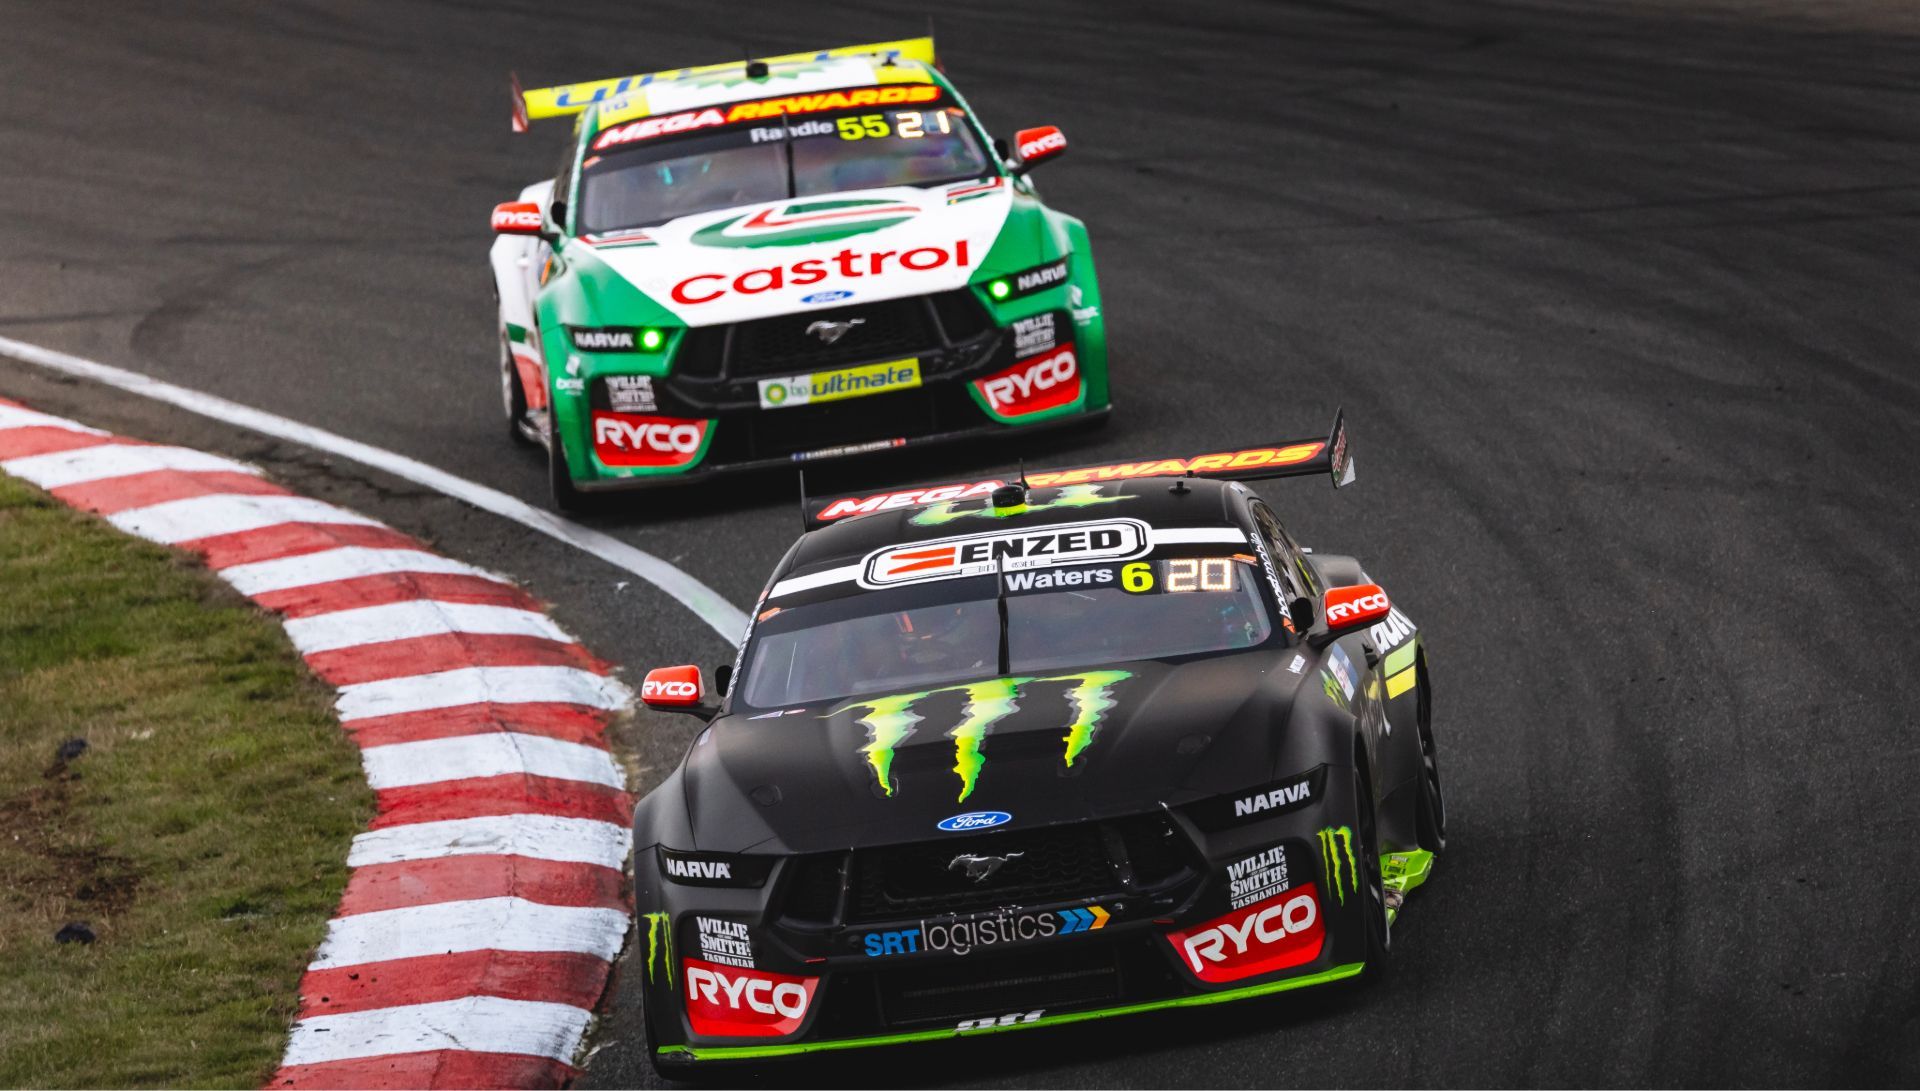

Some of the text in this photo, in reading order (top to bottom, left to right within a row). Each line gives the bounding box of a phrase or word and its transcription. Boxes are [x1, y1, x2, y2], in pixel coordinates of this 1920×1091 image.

[594, 85, 941, 151] MEGA REWARDS
[836, 113, 891, 141] 55
[671, 240, 969, 305] Castrol
[574, 332, 634, 348] NARVA
[812, 367, 914, 397] ultimate
[984, 351, 1076, 409] RYCO
[595, 417, 700, 454] RYCO
[819, 479, 1003, 518] MEGA
[1022, 443, 1323, 487] REWARDS
[960, 529, 1123, 564] ENZED
[1004, 559, 1232, 593] Waters 6 20
[1327, 593, 1389, 621] RYCO
[642, 681, 697, 697] RYCO
[1234, 782, 1311, 817] NARVA
[952, 814, 997, 829] Ford
[667, 857, 731, 879] NARVA
[1226, 845, 1286, 881] WILLIE
[1231, 881, 1289, 910] TASMANIAN
[696, 916, 750, 941] WILLIE
[1184, 894, 1317, 974] RYCO
[702, 952, 755, 969] TASMANIAN
[687, 966, 808, 1019] RYCO
